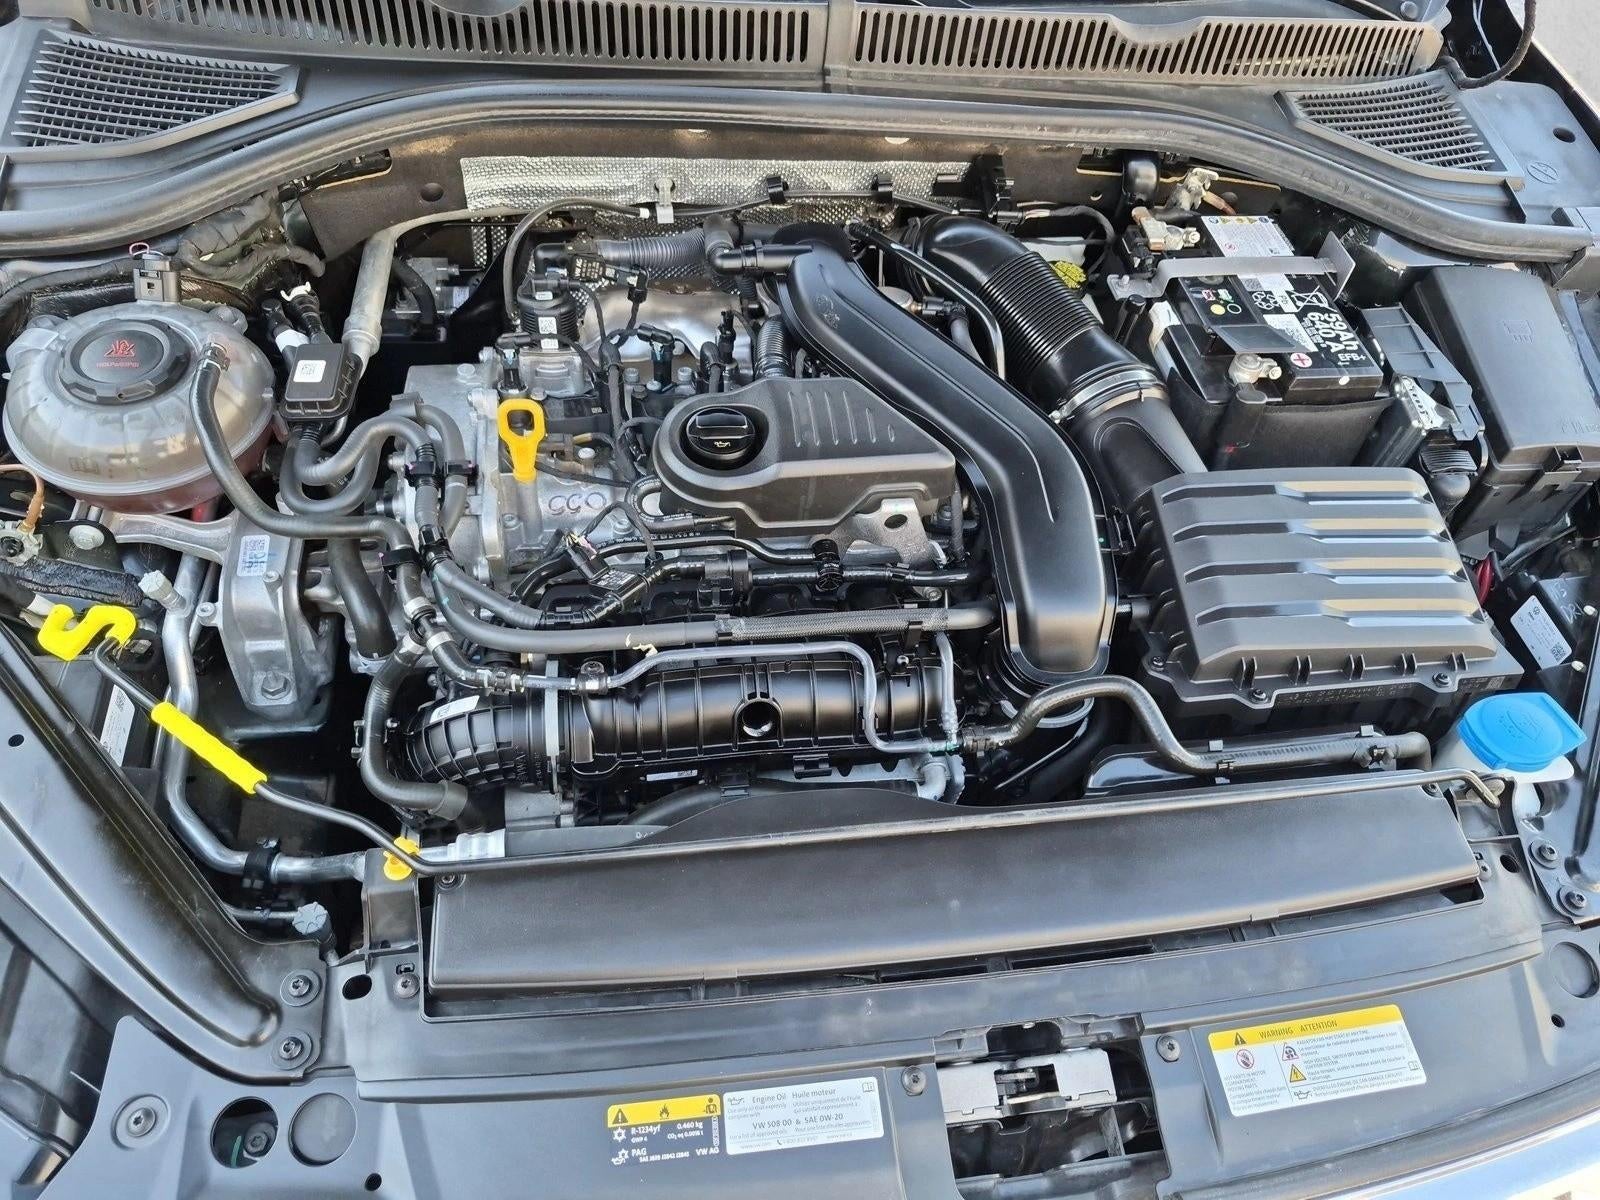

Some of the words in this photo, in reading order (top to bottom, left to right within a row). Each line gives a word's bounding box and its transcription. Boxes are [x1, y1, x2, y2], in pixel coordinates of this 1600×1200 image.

[1307, 312, 1336, 338] 640
[1325, 340, 1345, 353] A
[1324, 312, 1360, 350] 59Ah
[1338, 353, 1366, 362] EFB+
[1259, 1026, 1294, 1038] WARNING
[1300, 1020, 1338, 1032] ATTENTION
[752, 1094, 775, 1104] Engine
[776, 1092, 786, 1100] Oil
[792, 1090, 810, 1098] Huile
[811, 1088, 836, 1096] moteur
[677, 1122, 694, 1130] 0.460
[696, 1120, 704, 1129] kg
[752, 1122, 766, 1130] VW
[768, 1120, 780, 1128] 508
[782, 1118, 792, 1126] 00
[804, 1116, 818, 1124] SAE
[820, 1113, 844, 1122] 0W-20
[631, 1124, 661, 1135] R-1234yf
[632, 1148, 646, 1156] PAG
[696, 1148, 708, 1156] VW
[709, 1146, 720, 1154] AG
